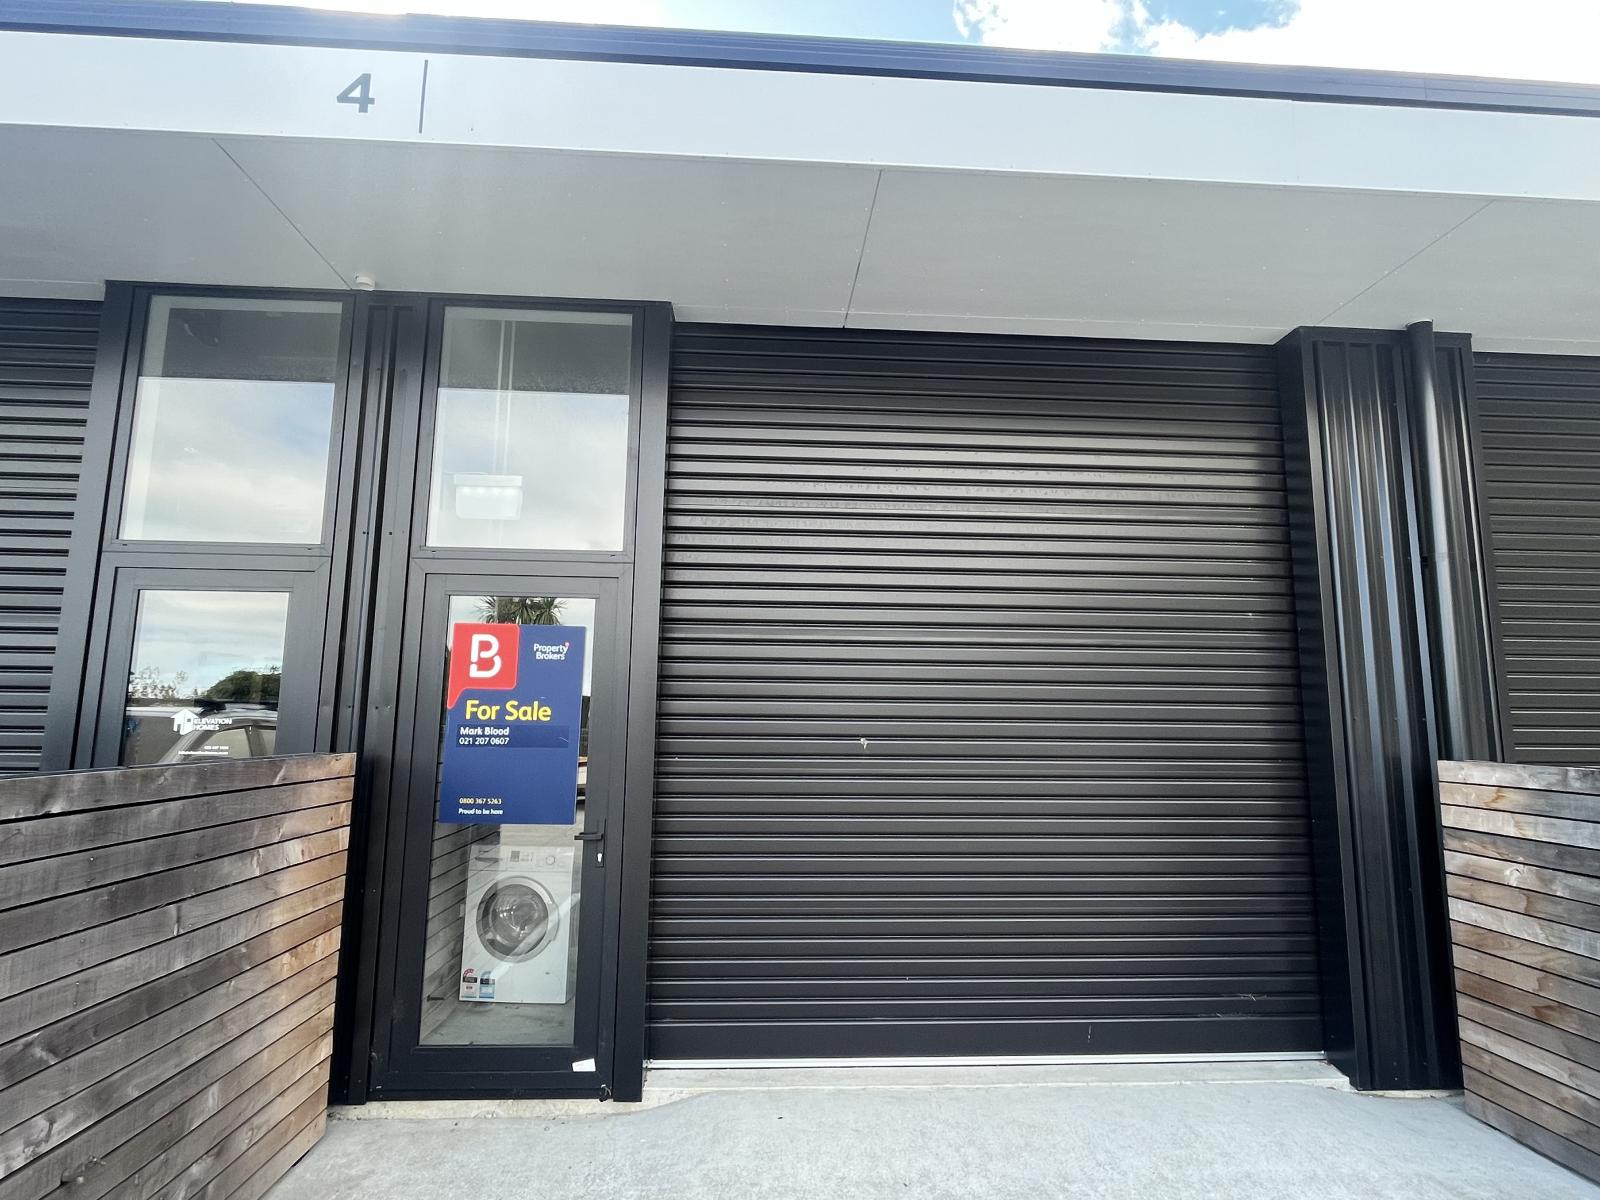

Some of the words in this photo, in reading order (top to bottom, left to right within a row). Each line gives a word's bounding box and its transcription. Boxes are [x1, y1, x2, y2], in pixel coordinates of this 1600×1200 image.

[337, 73, 375, 113] 4
[534, 642, 569, 653] Property
[535, 652, 565, 660] Brokers
[465, 699, 500, 721] For
[505, 700, 552, 721] Sale
[460, 726, 483, 736] Mark
[484, 726, 510, 736] Blood
[459, 737, 473, 745] 021
[475, 737, 489, 745] 207
[490, 737, 509, 745] 0607
